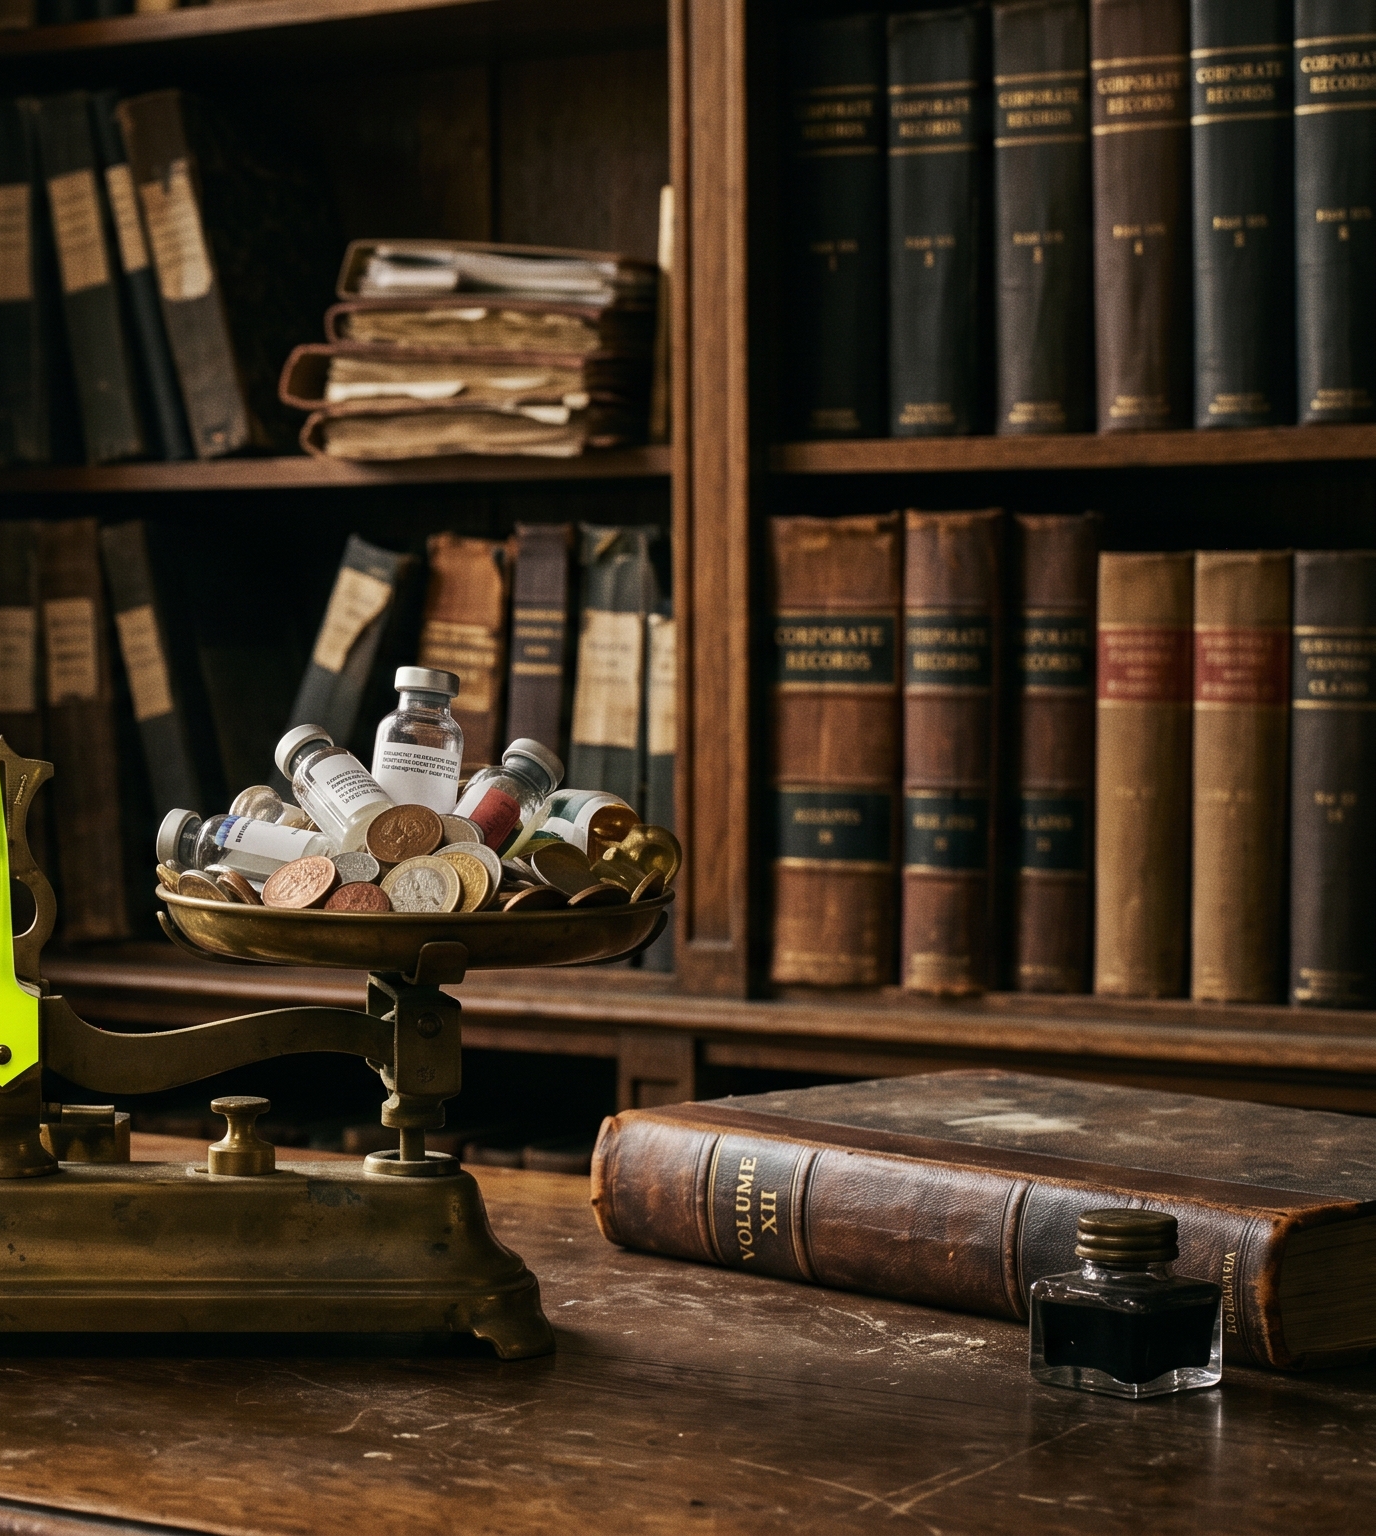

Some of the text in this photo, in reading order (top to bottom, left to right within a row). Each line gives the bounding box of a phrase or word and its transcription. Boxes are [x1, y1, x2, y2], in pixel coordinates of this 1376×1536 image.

[1097, 72, 1180, 95] CORPORATE
[1196, 61, 1284, 85] CORPORATE
[775, 626, 884, 648] CORPORATE
[785, 650, 872, 671] RECORDS
[912, 652, 981, 671] RECORDS
[735, 1157, 757, 1260] VOLUME
[760, 1190, 778, 1235] XII
